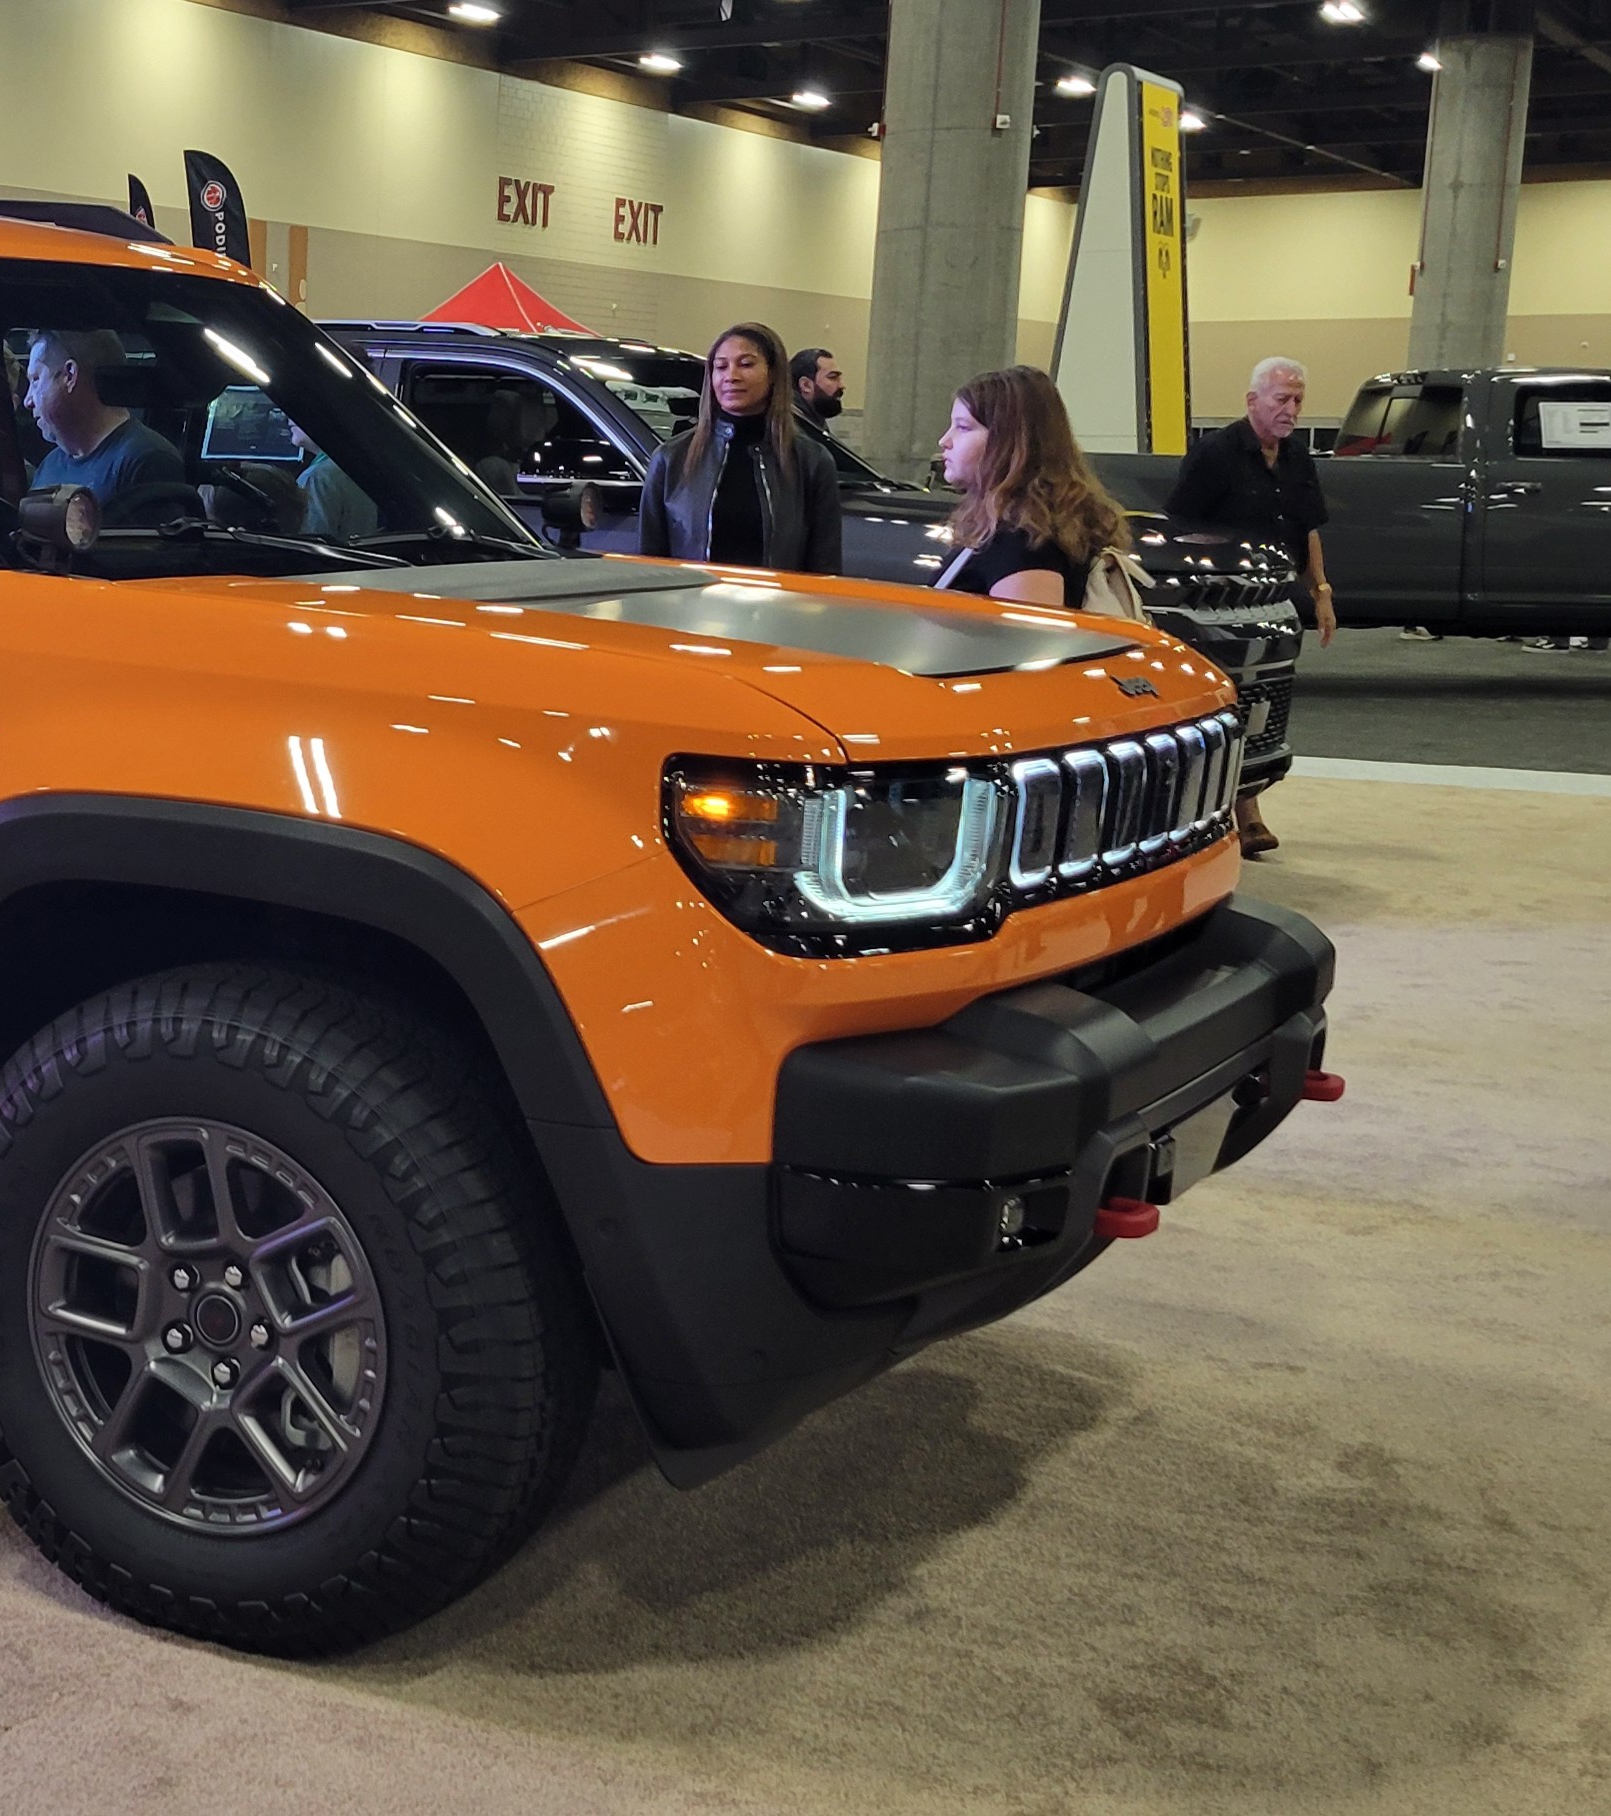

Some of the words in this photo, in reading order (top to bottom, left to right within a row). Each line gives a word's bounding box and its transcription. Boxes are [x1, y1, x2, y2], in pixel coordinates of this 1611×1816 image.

[497, 176, 555, 228] EXIT
[614, 197, 664, 245] EXIT
[1152, 193, 1173, 238] RAM
[214, 211, 227, 257] PODI
